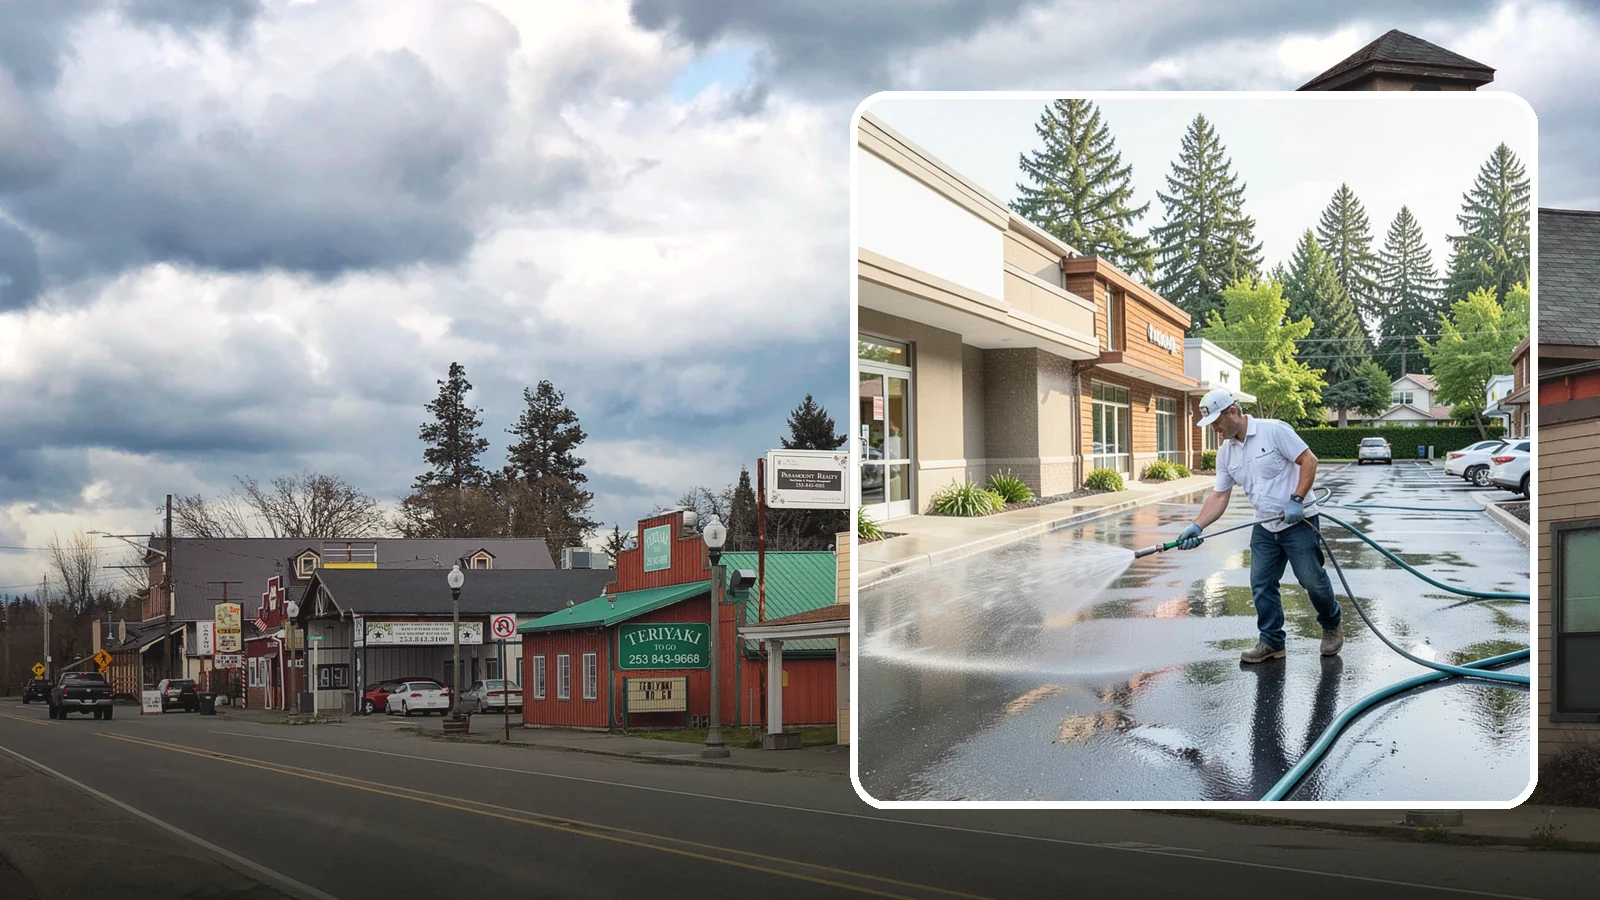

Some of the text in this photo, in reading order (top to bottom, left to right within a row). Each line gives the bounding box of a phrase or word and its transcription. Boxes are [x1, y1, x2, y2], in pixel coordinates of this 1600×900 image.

[625, 628, 702, 645] TERIYAKI
[629, 654, 700, 664] 253 843-9668
